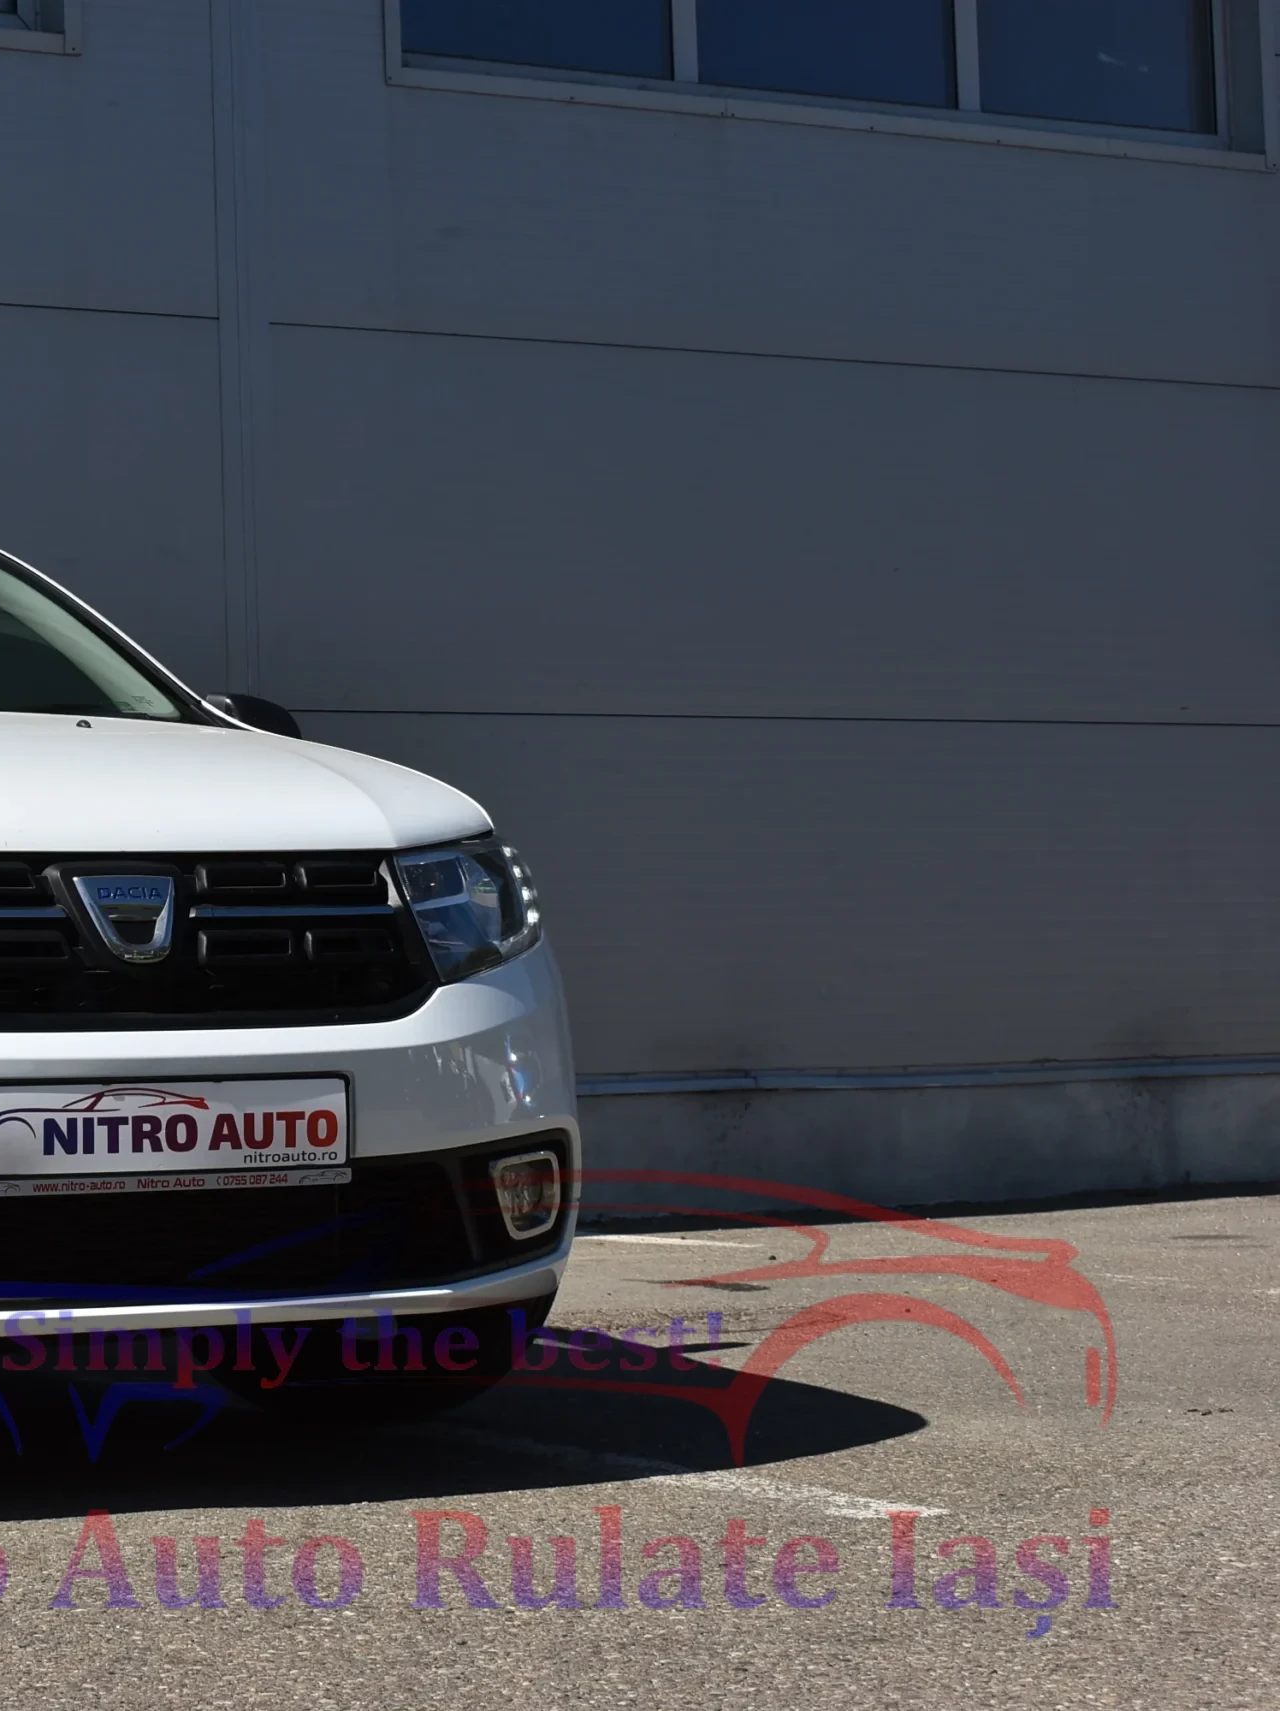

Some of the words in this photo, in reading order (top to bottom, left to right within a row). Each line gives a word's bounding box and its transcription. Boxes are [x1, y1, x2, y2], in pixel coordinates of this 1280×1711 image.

[97, 886, 162, 900] DACIA
[42, 1113, 198, 1156] NITRO
[207, 1109, 339, 1152] AUTO
[243, 1149, 338, 1164] nitroauto.ro
[32, 1179, 126, 1192] www.nitro-auto.ro
[136, 1177, 170, 1189] Nitro
[173, 1176, 205, 1188] Auto
[223, 1175, 247, 1186] 0755
[269, 1173, 288, 1184] 244
